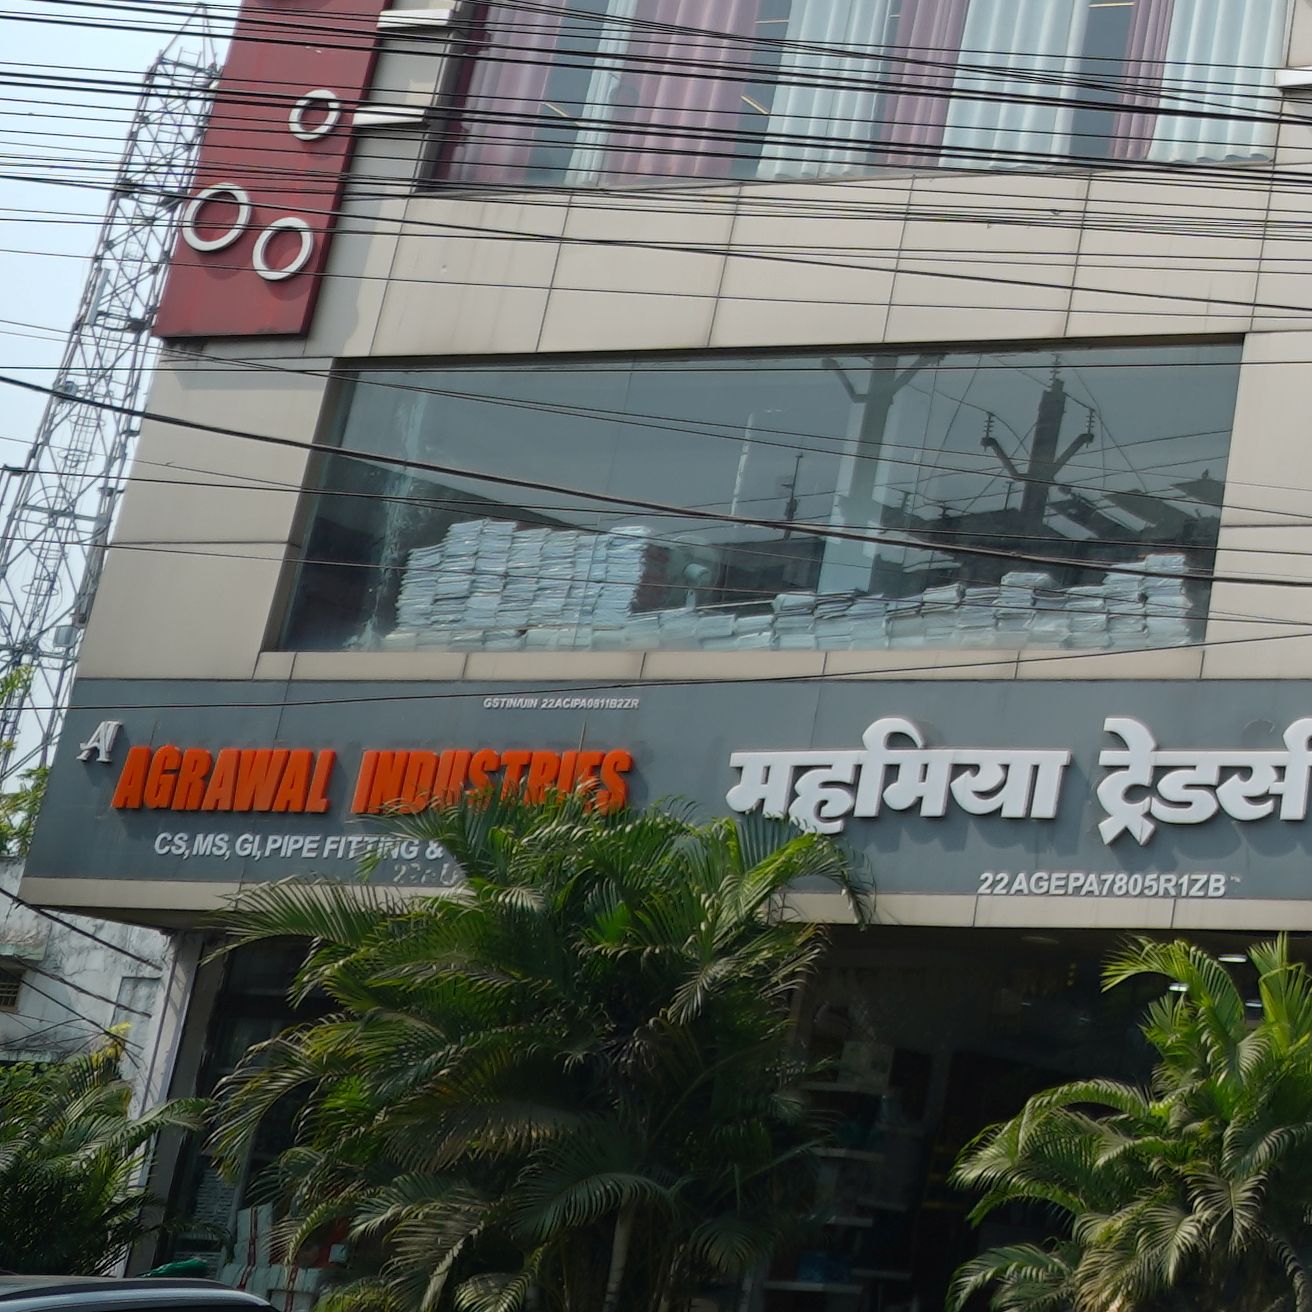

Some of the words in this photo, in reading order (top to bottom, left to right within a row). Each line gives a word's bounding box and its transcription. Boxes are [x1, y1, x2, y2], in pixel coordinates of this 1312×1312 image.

[111, 744, 337, 813] AGRAWAL
[352, 749, 633, 815] INDUSTRIES
[264, 835, 320, 858] PIPE
[977, 872, 1227, 897] 22AGEPA7805R1ZB
